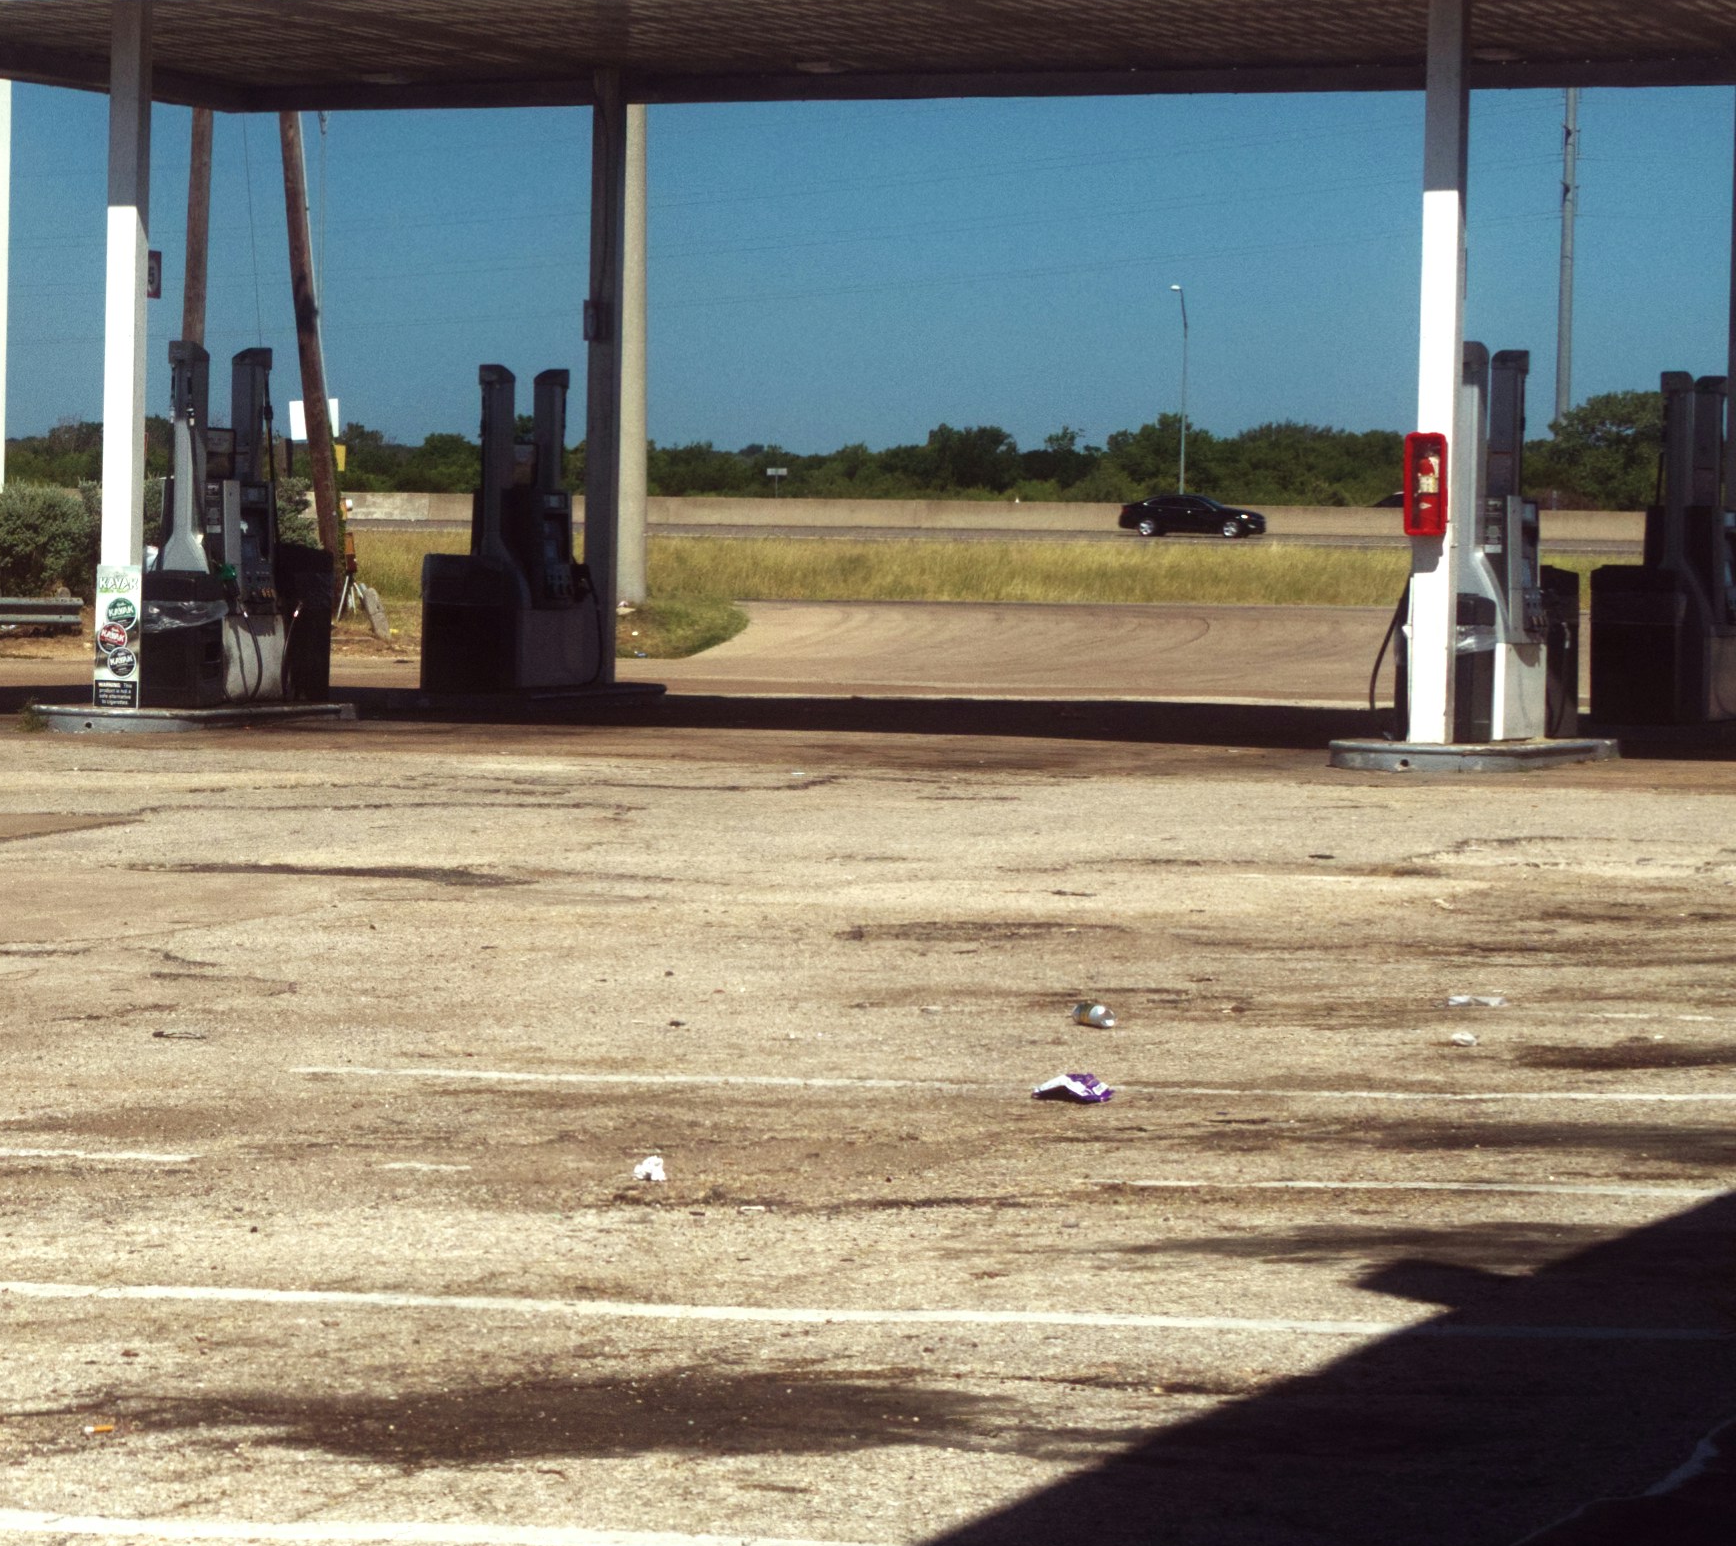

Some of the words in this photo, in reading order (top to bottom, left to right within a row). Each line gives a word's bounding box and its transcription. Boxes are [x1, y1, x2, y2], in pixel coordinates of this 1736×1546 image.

[99, 577, 139, 590] KAYAK
[108, 605, 134, 617] KAYAK
[101, 629, 125, 642] KAYAK
[109, 655, 133, 666] KAYAK
